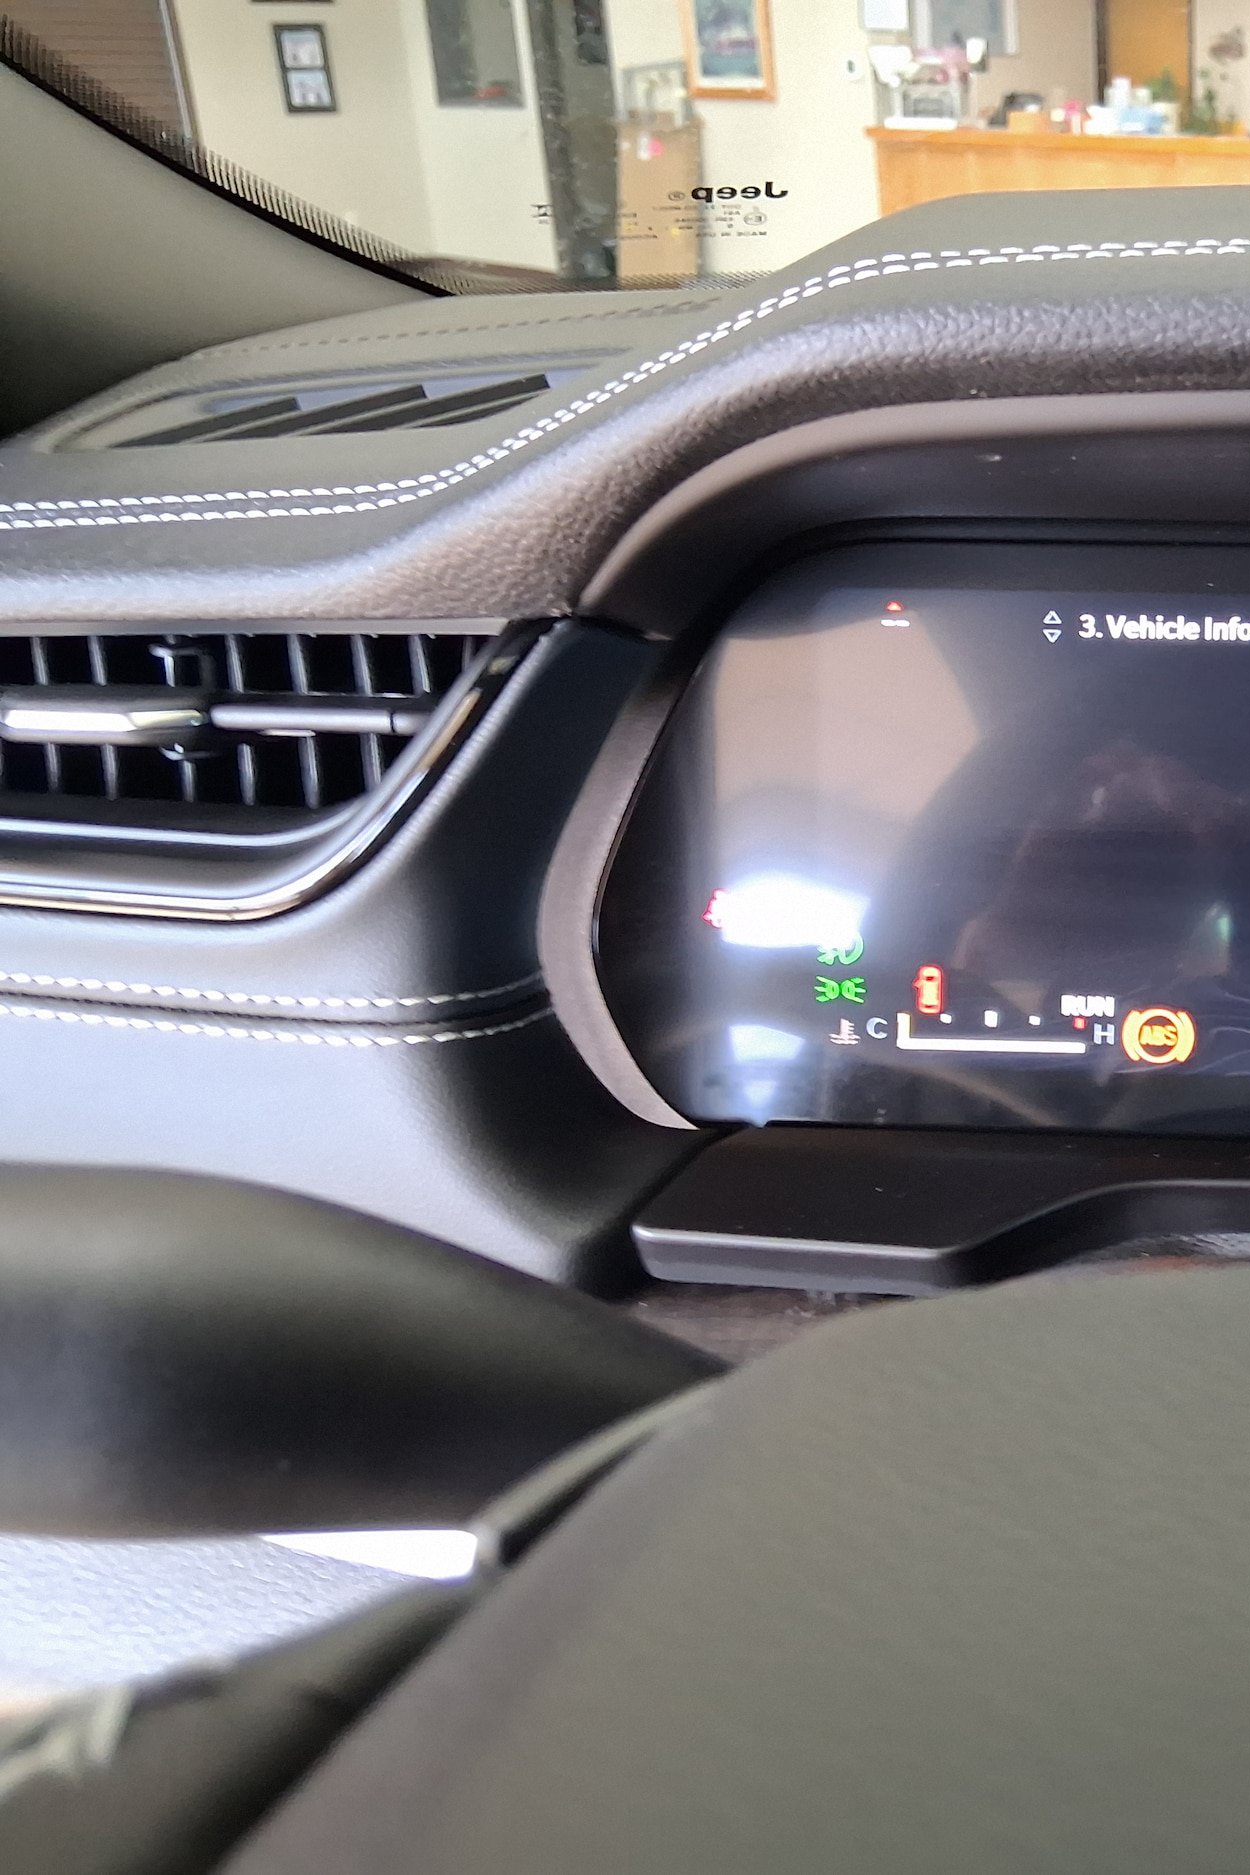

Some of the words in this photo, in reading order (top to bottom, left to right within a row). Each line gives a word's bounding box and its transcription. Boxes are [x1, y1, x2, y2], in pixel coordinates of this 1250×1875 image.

[1077, 614, 1104, 640] 3.
[1105, 614, 1201, 641] Vehicle
[1060, 994, 1115, 1018] RUN
[865, 1017, 889, 1039] C
[1092, 1023, 1116, 1046] H
[1139, 1023, 1179, 1047] ABS
